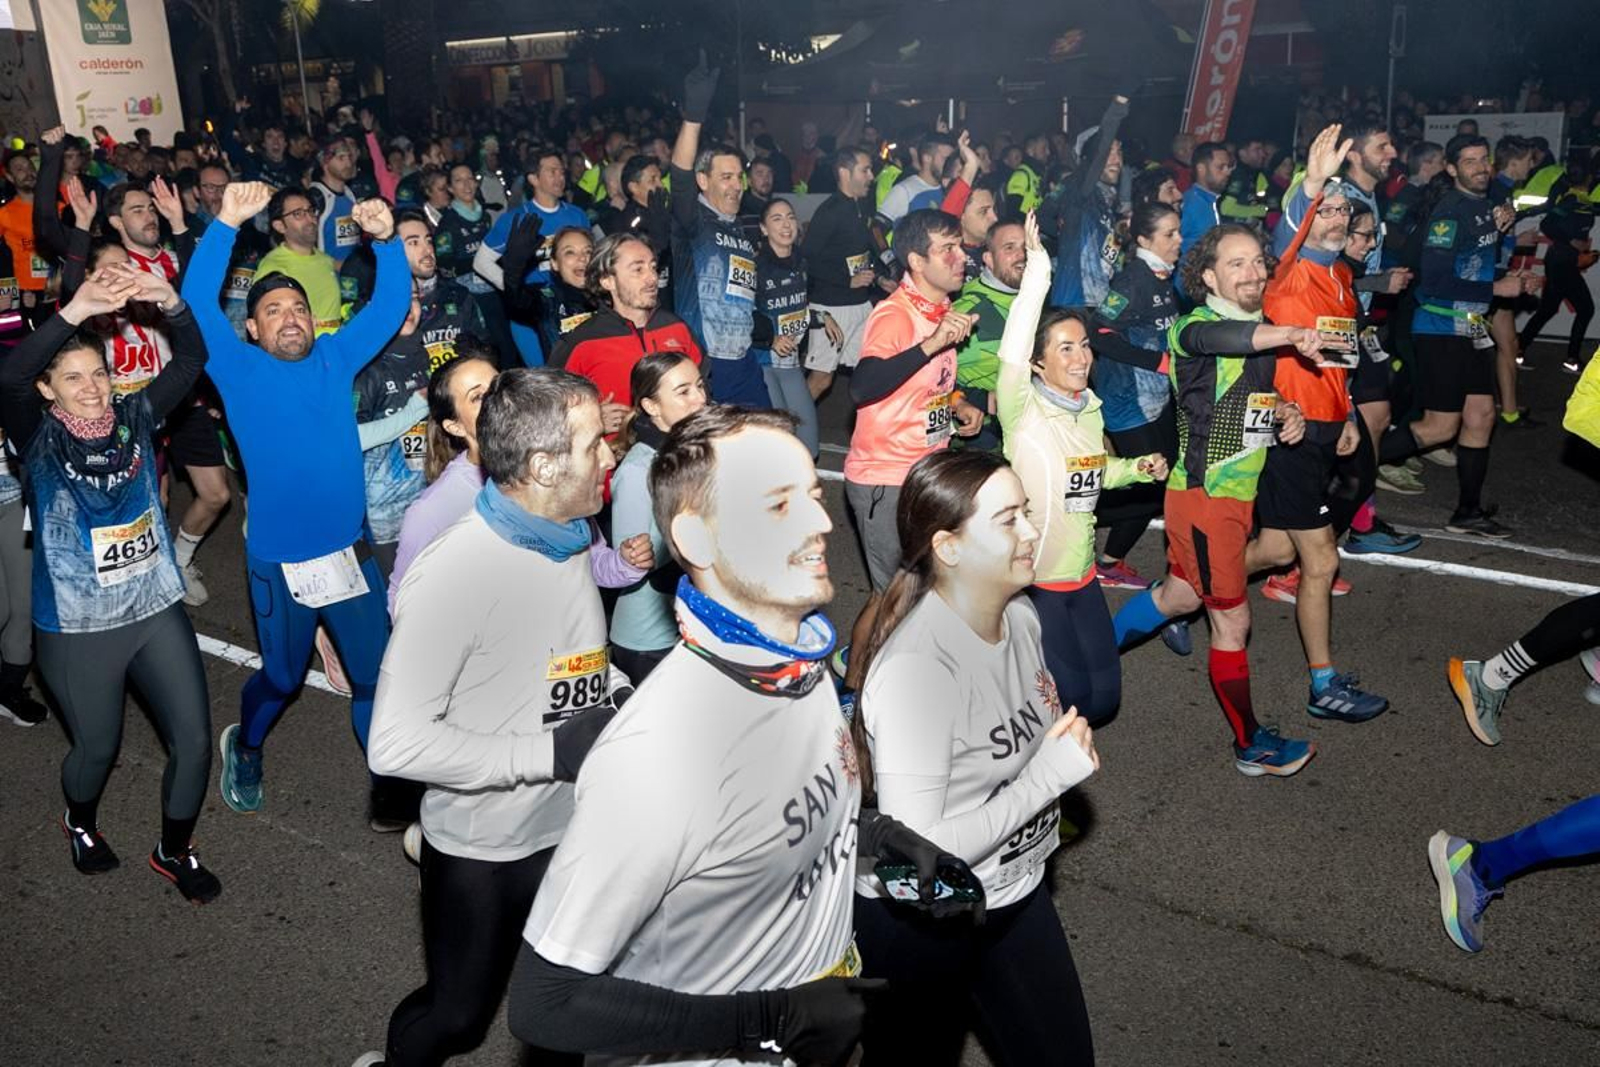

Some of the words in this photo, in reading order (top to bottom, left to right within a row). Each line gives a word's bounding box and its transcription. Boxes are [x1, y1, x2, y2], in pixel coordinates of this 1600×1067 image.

[79, 57, 144, 70] calderón
[716, 232, 737, 250] SAN
[767, 298, 787, 310] SAN
[781, 320, 808, 337] 6836
[102, 527, 156, 563] 4631
[567, 656, 583, 673] 42
[989, 701, 1044, 761] SAN
[782, 763, 838, 848] SAN
